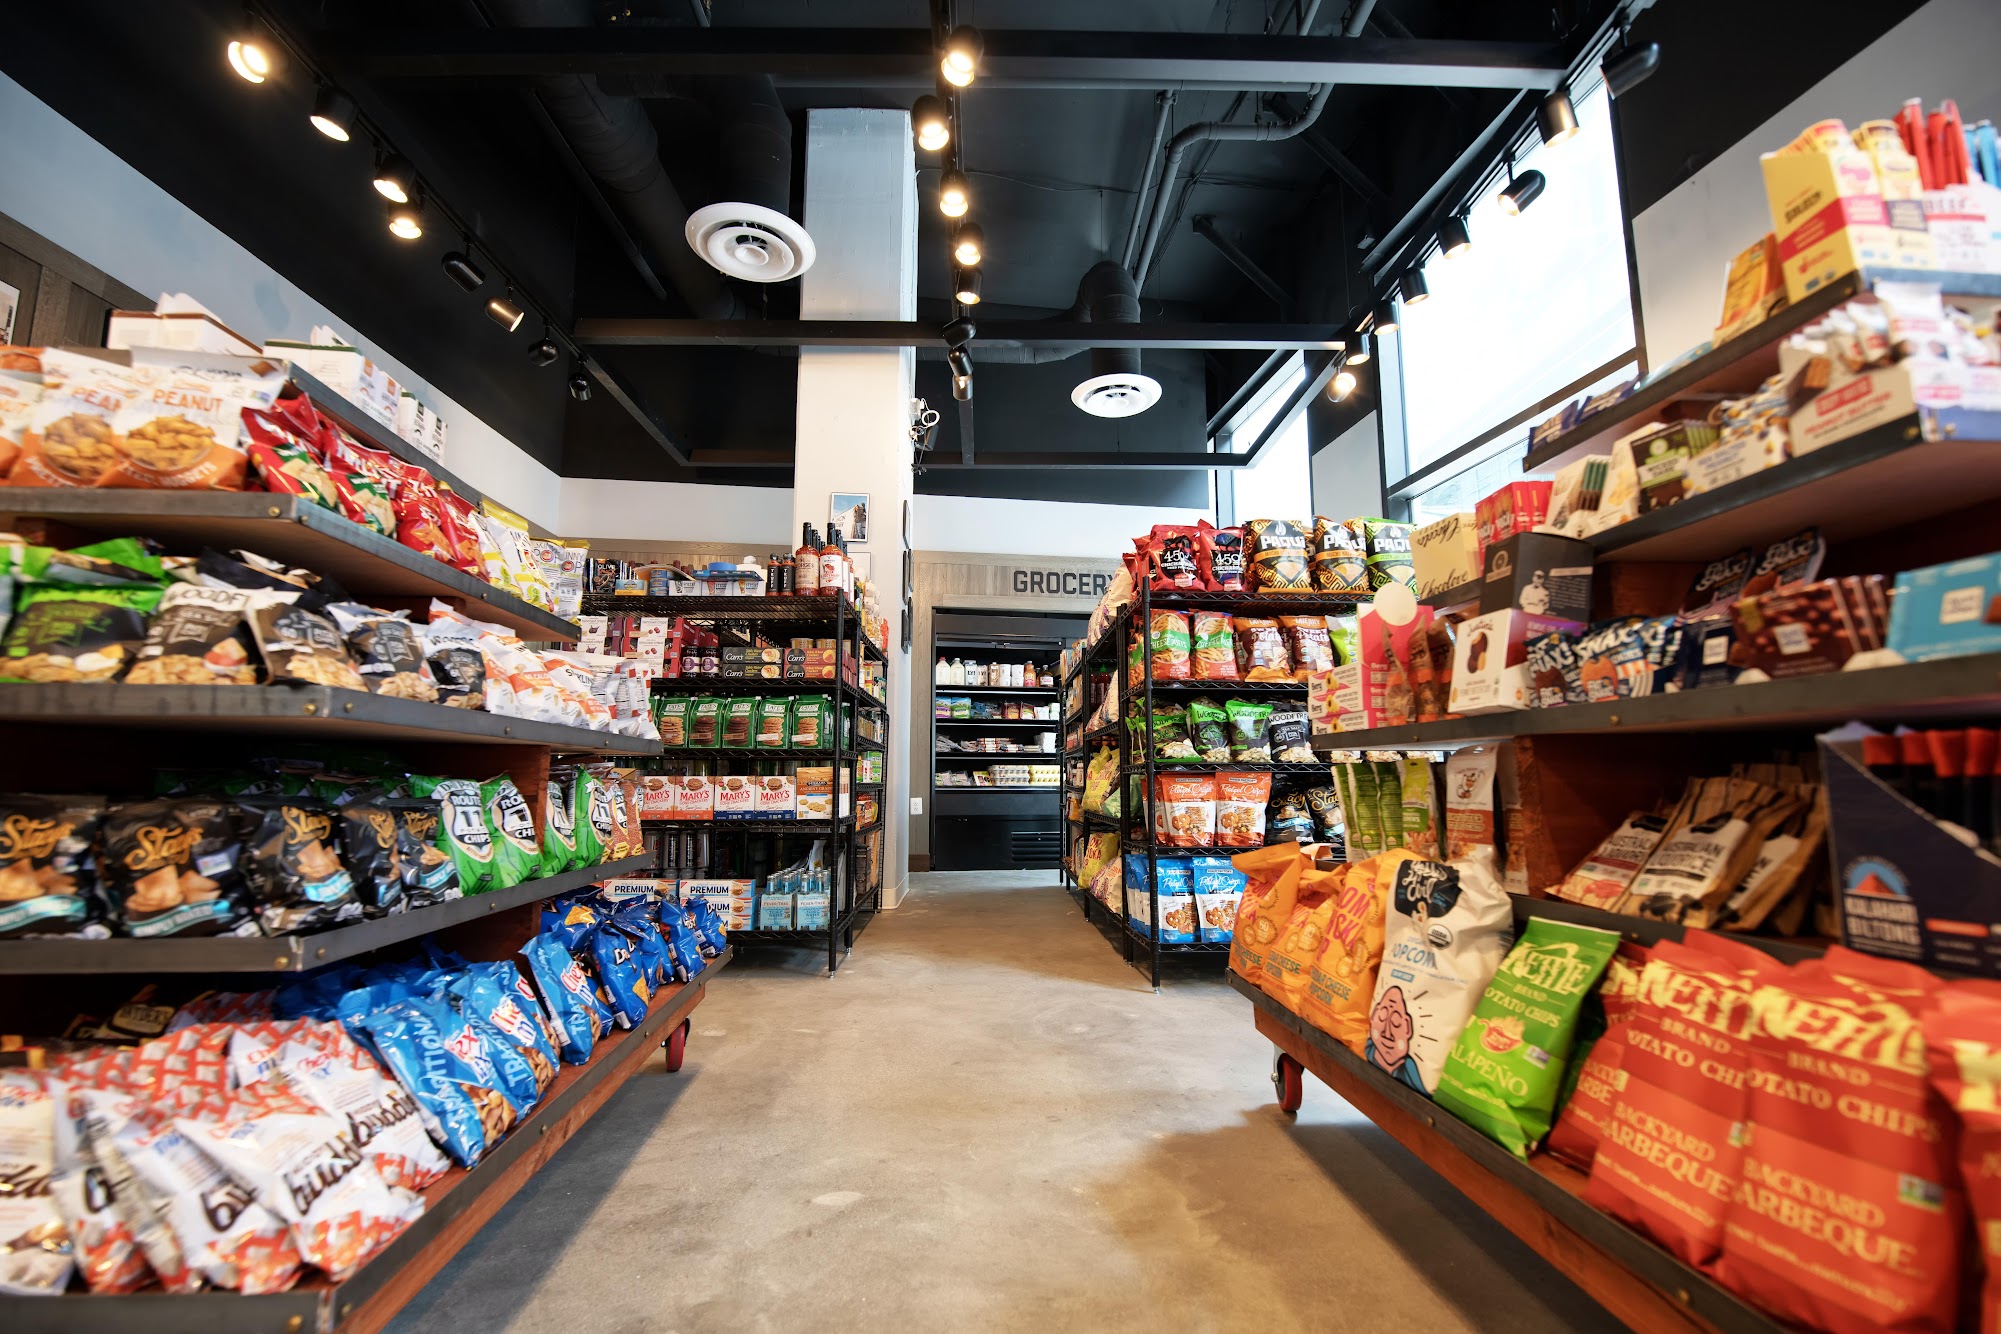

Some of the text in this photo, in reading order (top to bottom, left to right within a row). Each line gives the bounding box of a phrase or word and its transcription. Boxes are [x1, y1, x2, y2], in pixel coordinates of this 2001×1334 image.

[152, 388, 224, 413] PEANUT
[452, 794, 482, 806] ROUTE
[680, 789, 710, 801] MARY'S
[720, 789, 750, 801] MARY'S
[760, 789, 790, 801] MARY'S
[459, 808, 482, 828] 11
[464, 833, 491, 844] CHIPS
[614, 885, 654, 894] PREMIUM
[690, 885, 729, 894] PREMIUM
[1499, 941, 1592, 996] KETTLE
[1524, 1005, 1562, 1029] CHIPS
[1660, 1016, 1732, 1054] BRAND
[1786, 1049, 1872, 1088] BRAND
[1836, 1092, 1942, 1144] CHIPS
